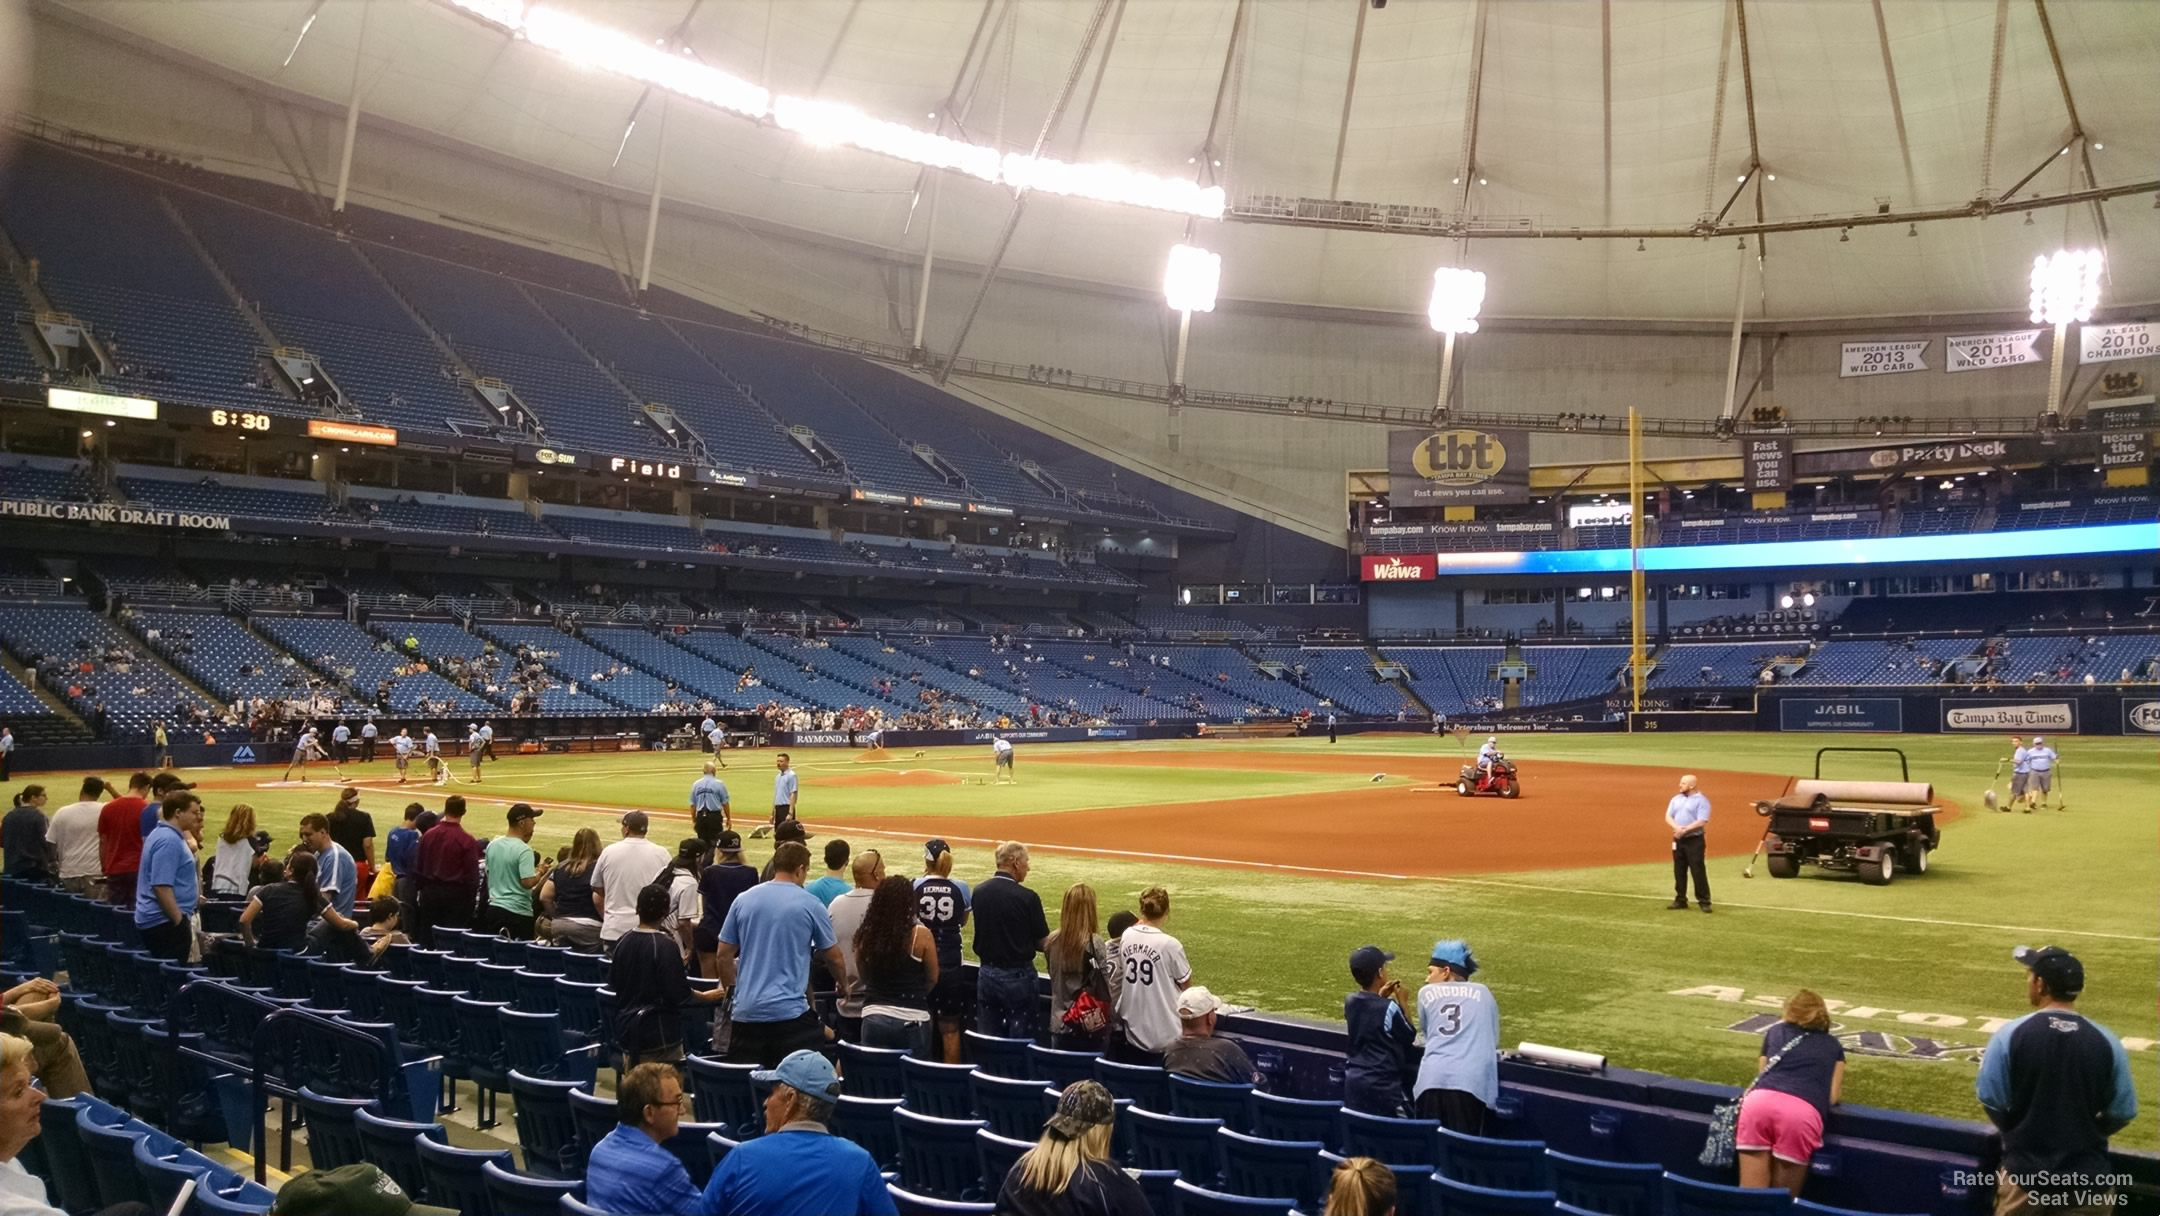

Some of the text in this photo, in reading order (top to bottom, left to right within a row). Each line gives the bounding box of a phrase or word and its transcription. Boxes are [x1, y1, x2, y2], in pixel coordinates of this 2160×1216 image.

[2121, 325, 2147, 334] EAST
[1949, 334, 2033, 347] AMERICAN LEAGUE
[2101, 332, 2150, 349] 2010
[1844, 343, 1922, 353] AMERICAN LEAGUE
[1969, 343, 2013, 358] 2011
[2086, 344, 2160, 359] CHAMPIONS
[1863, 351, 1905, 365] 2013
[1956, 353, 2026, 367] WILD CARD
[1850, 362, 1915, 373] WILD CARD
[211, 410, 271, 431] 6:30
[1426, 434, 1494, 471] tbt
[1753, 441, 1779, 451] Fast
[1902, 441, 2007, 462] Party Deck
[2111, 442, 2136, 454] the
[558, 453, 576, 465] SUN
[1752, 451, 1783, 460] news
[2103, 451, 2145, 465] buzz?
[611, 457, 680, 479] Field
[1757, 461, 1779, 472] you
[1757, 469, 1779, 478] can
[1756, 479, 1780, 488] use.
[1413, 489, 1432, 497] Fast
[1456, 490, 1471, 498] you
[1488, 488, 1505, 496] use.
[0, 500, 230, 530] PUBLIC BANK DRAFT ROOM
[1370, 521, 1552, 536] tampabay.com Know it now. tampabay.com
[1374, 563, 1422, 580] Wawa
[1606, 700, 1620, 708] 162
[1815, 705, 1865, 714] JABIL
[1953, 710, 2066, 726] Tampa Bay Times
[1496, 723, 1532, 731] Welcomes
[1644, 721, 1658, 729] 315
[797, 735, 843, 743] RAYMOND
[919, 895, 955, 922] 39
[1125, 957, 1154, 987] 39
[1438, 1002, 1463, 1038] 3
